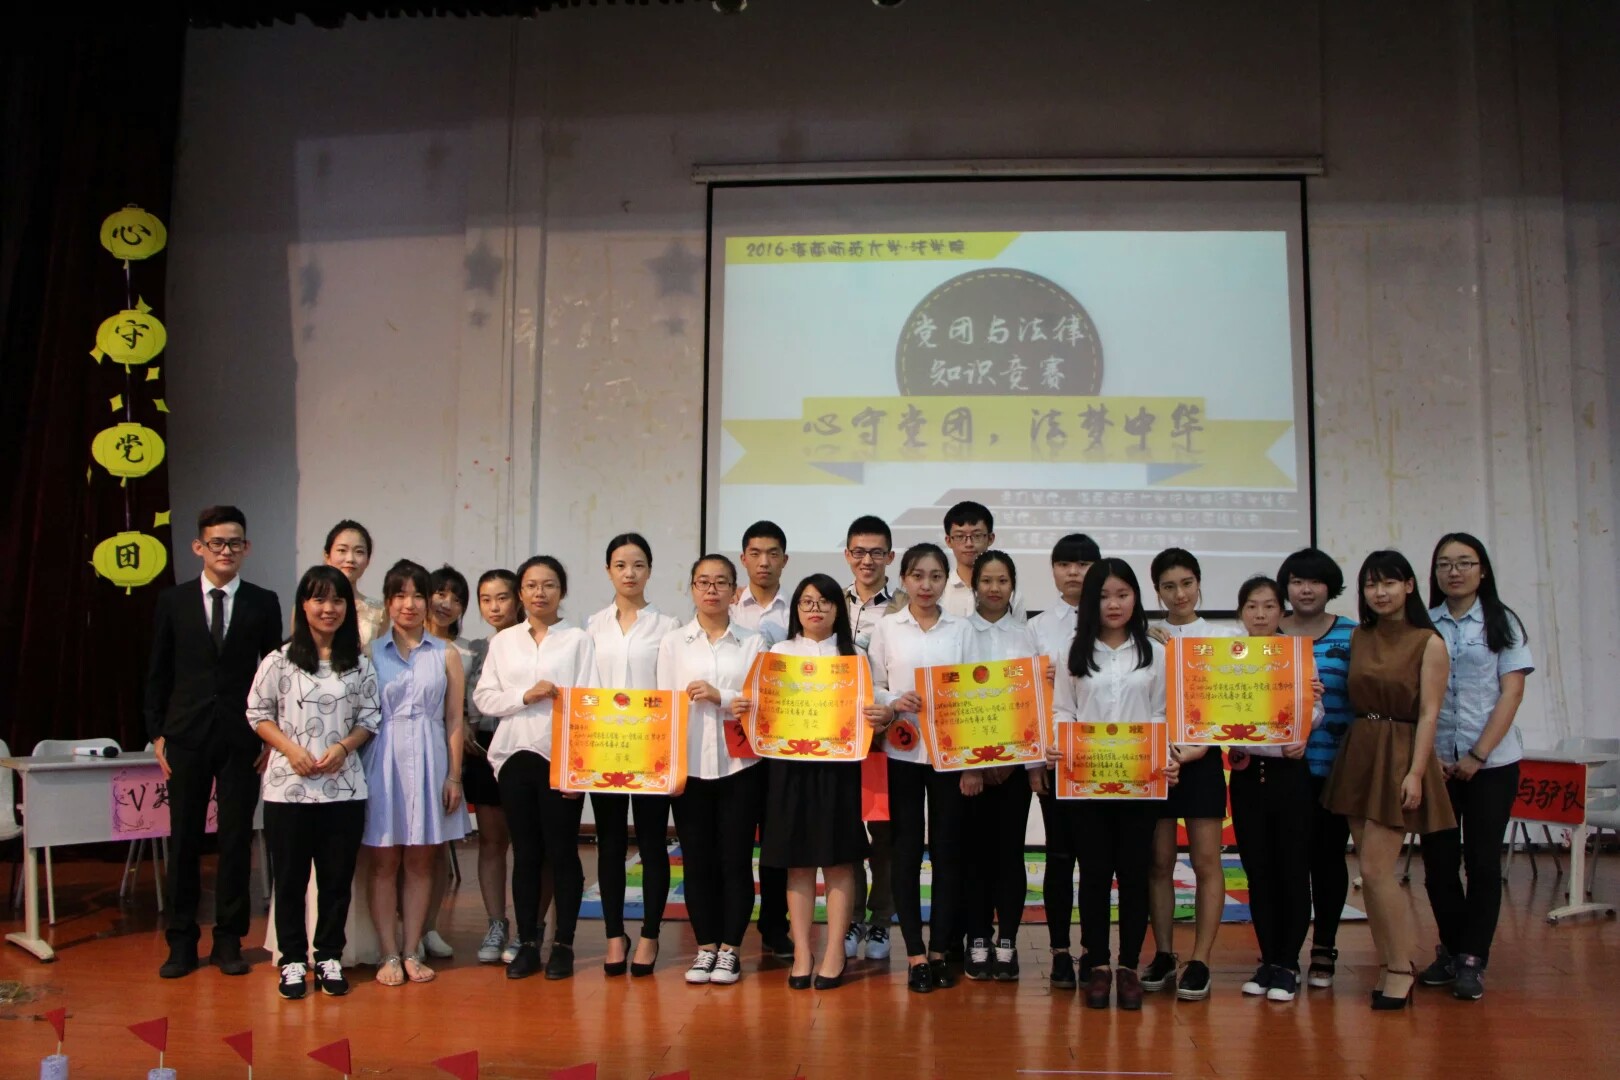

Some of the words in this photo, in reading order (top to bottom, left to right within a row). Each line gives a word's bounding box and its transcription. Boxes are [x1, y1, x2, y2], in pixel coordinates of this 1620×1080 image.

[112, 223, 152, 246] 心
[114, 319, 150, 351] 守
[913, 314, 1086, 349] 党团与法律
[929, 353, 1067, 391] 知识竞赛
[114, 433, 145, 464] 党
[115, 542, 141, 571] 团
